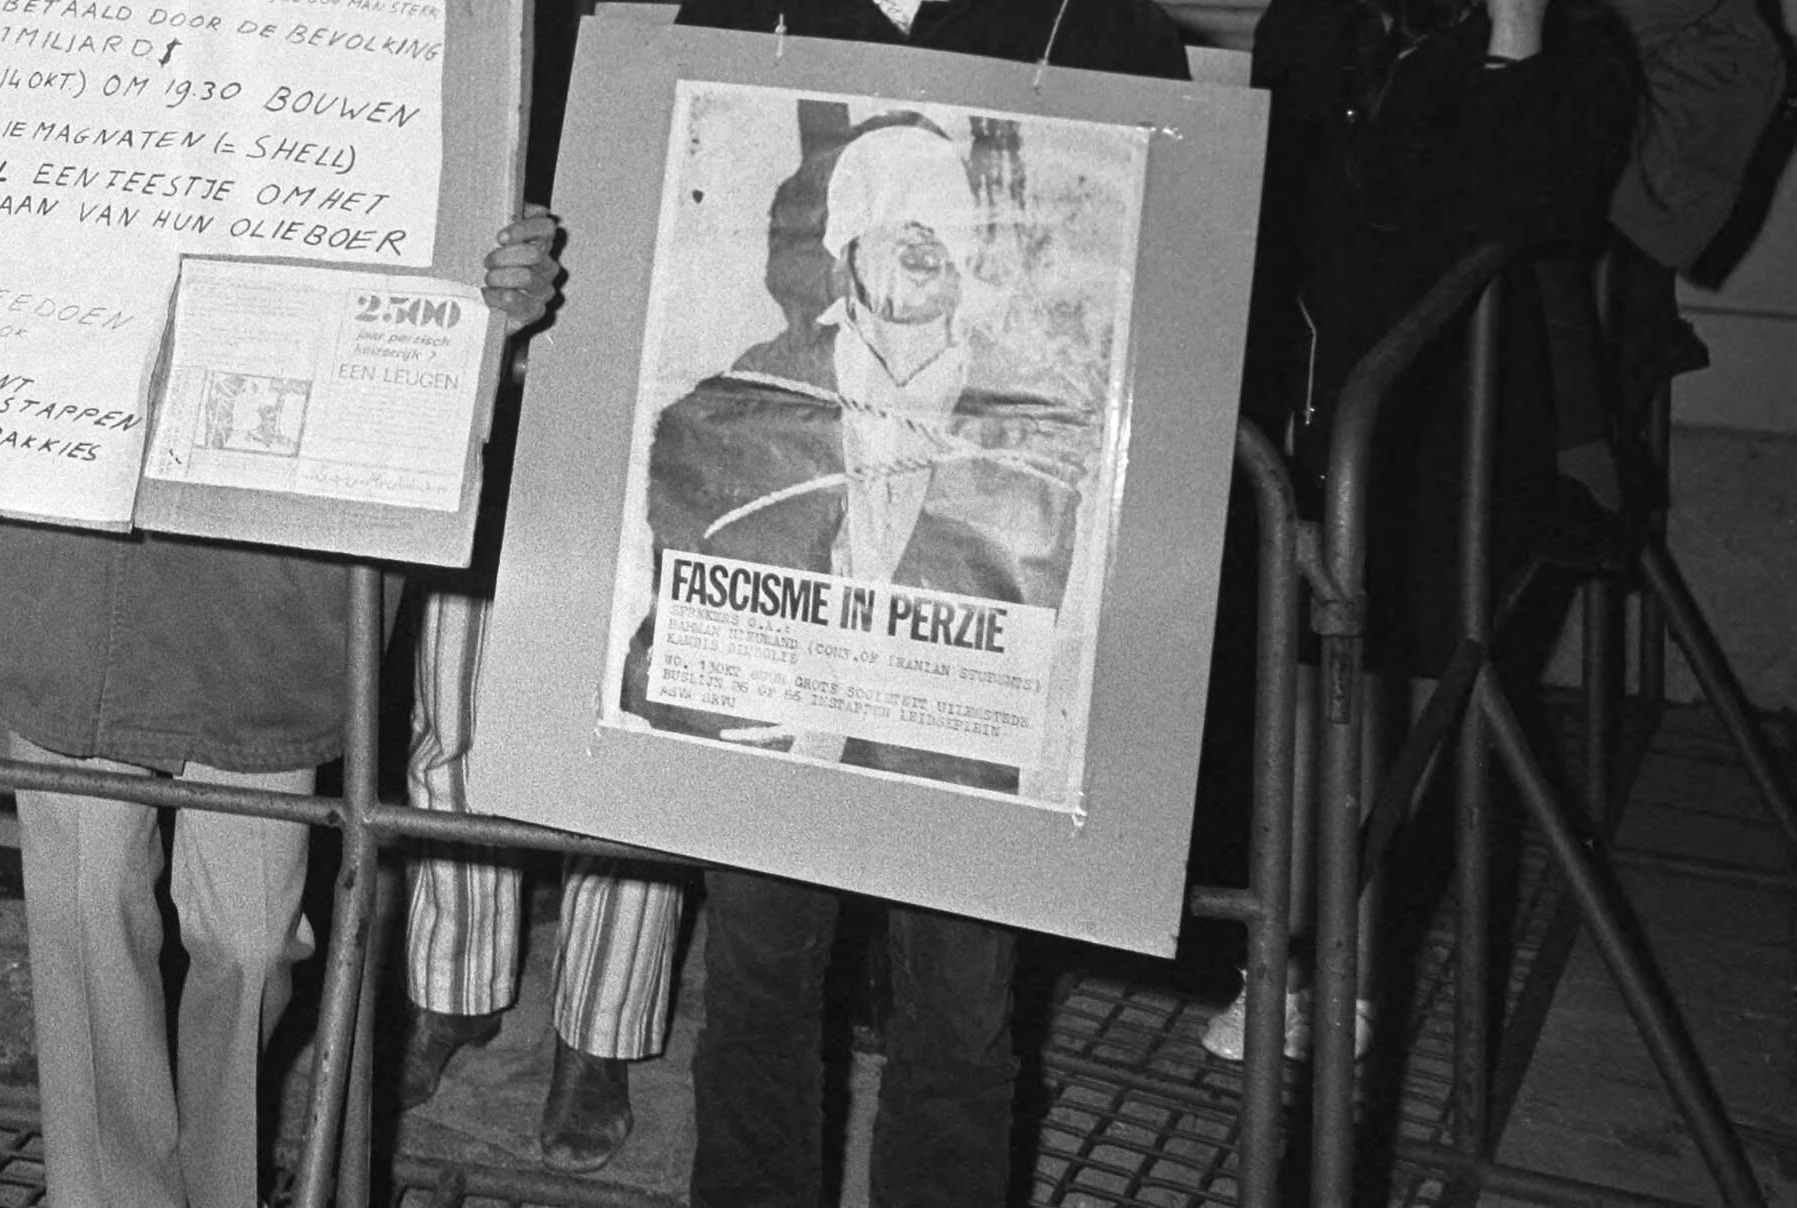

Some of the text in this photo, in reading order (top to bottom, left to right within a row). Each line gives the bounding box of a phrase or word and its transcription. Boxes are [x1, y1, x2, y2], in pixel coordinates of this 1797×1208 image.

[148, 7, 223, 32] DOOR
[236, 20, 278, 39] DE
[284, 23, 443, 63] BEVOLKING
[102, 73, 150, 97] OM
[164, 78, 242, 109] 19.30
[263, 84, 422, 129] BOUWEN
[245, 133, 357, 176] SHELL)
[32, 161, 100, 189] EEN
[255, 182, 317, 207] OM
[318, 186, 391, 216] HET
[77, 202, 141, 229] VAN
[152, 208, 216, 235] HUN
[228, 217, 408, 257] OLIEBOER
[354, 293, 463, 330] 2500
[337, 363, 460, 391] EEN LEUGEN
[670, 558, 1008, 653] FASCISME IN PERZIE
